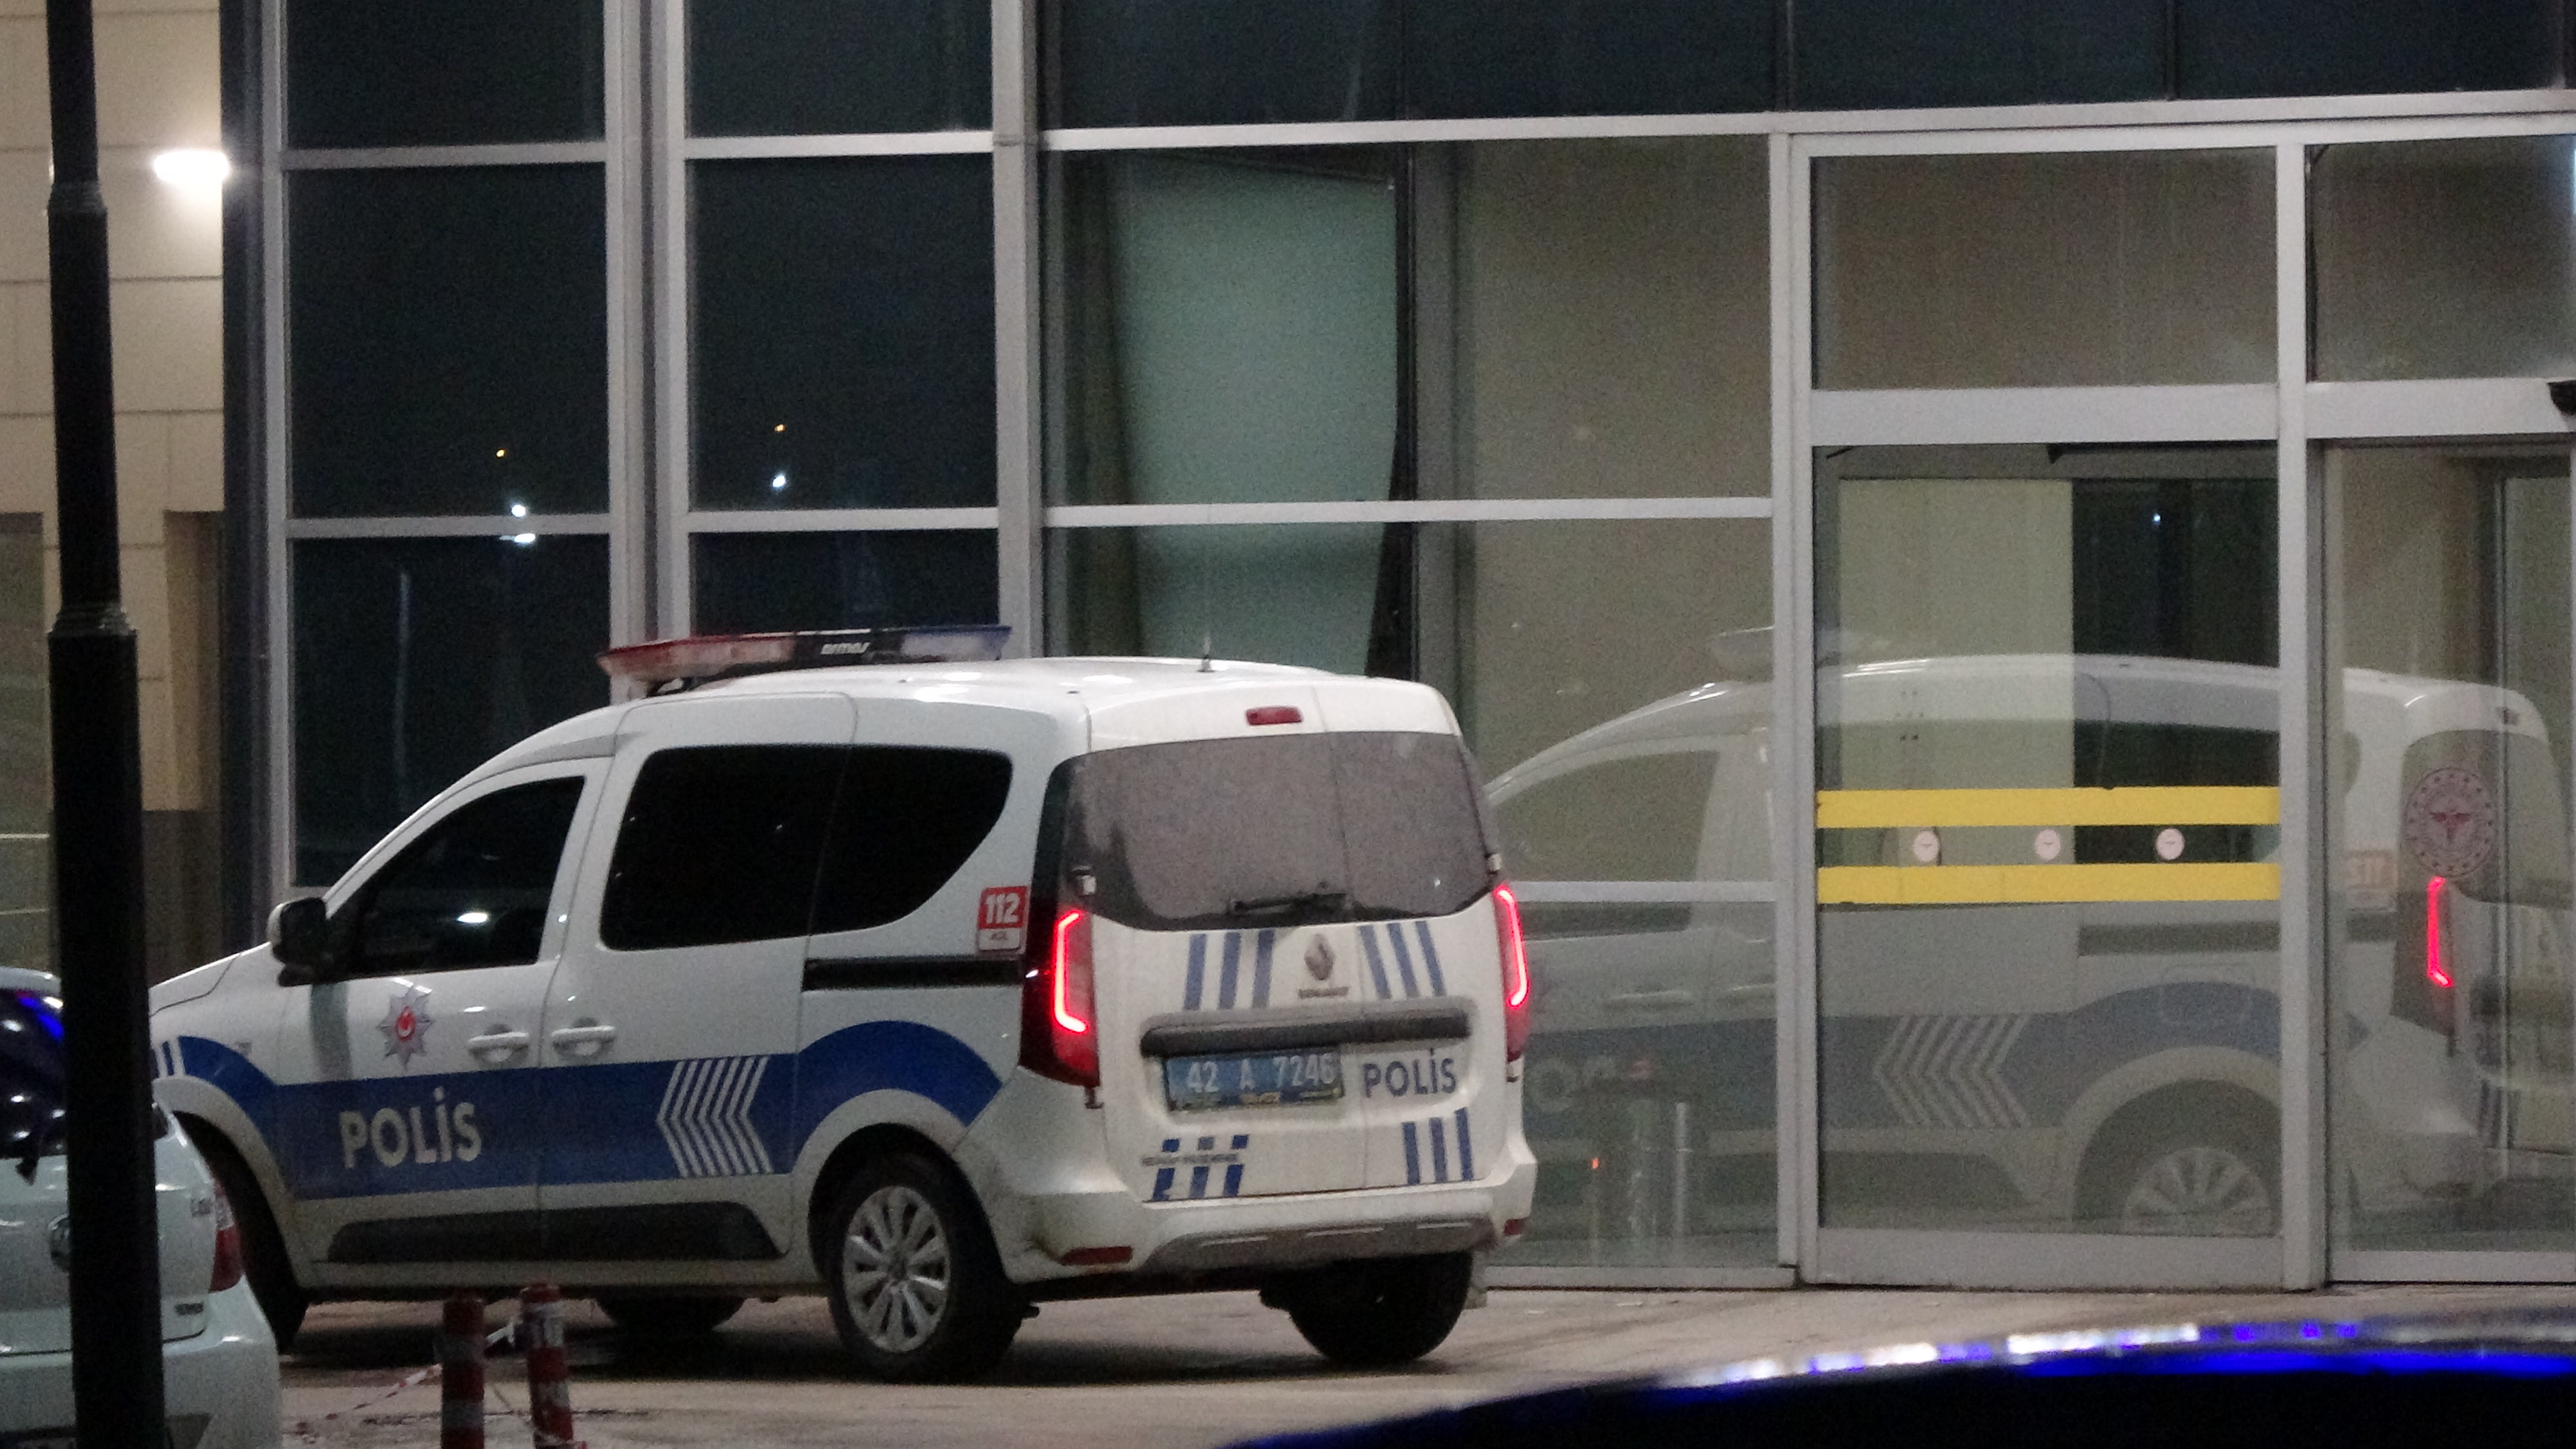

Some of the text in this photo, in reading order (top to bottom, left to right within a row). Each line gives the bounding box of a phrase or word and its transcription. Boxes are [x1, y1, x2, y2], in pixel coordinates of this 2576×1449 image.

[985, 892, 1020, 924] 112
[1186, 1061, 1220, 1093] 42
[1273, 1052, 1338, 1089] 7246
[339, 1085, 482, 1169] POLİS
